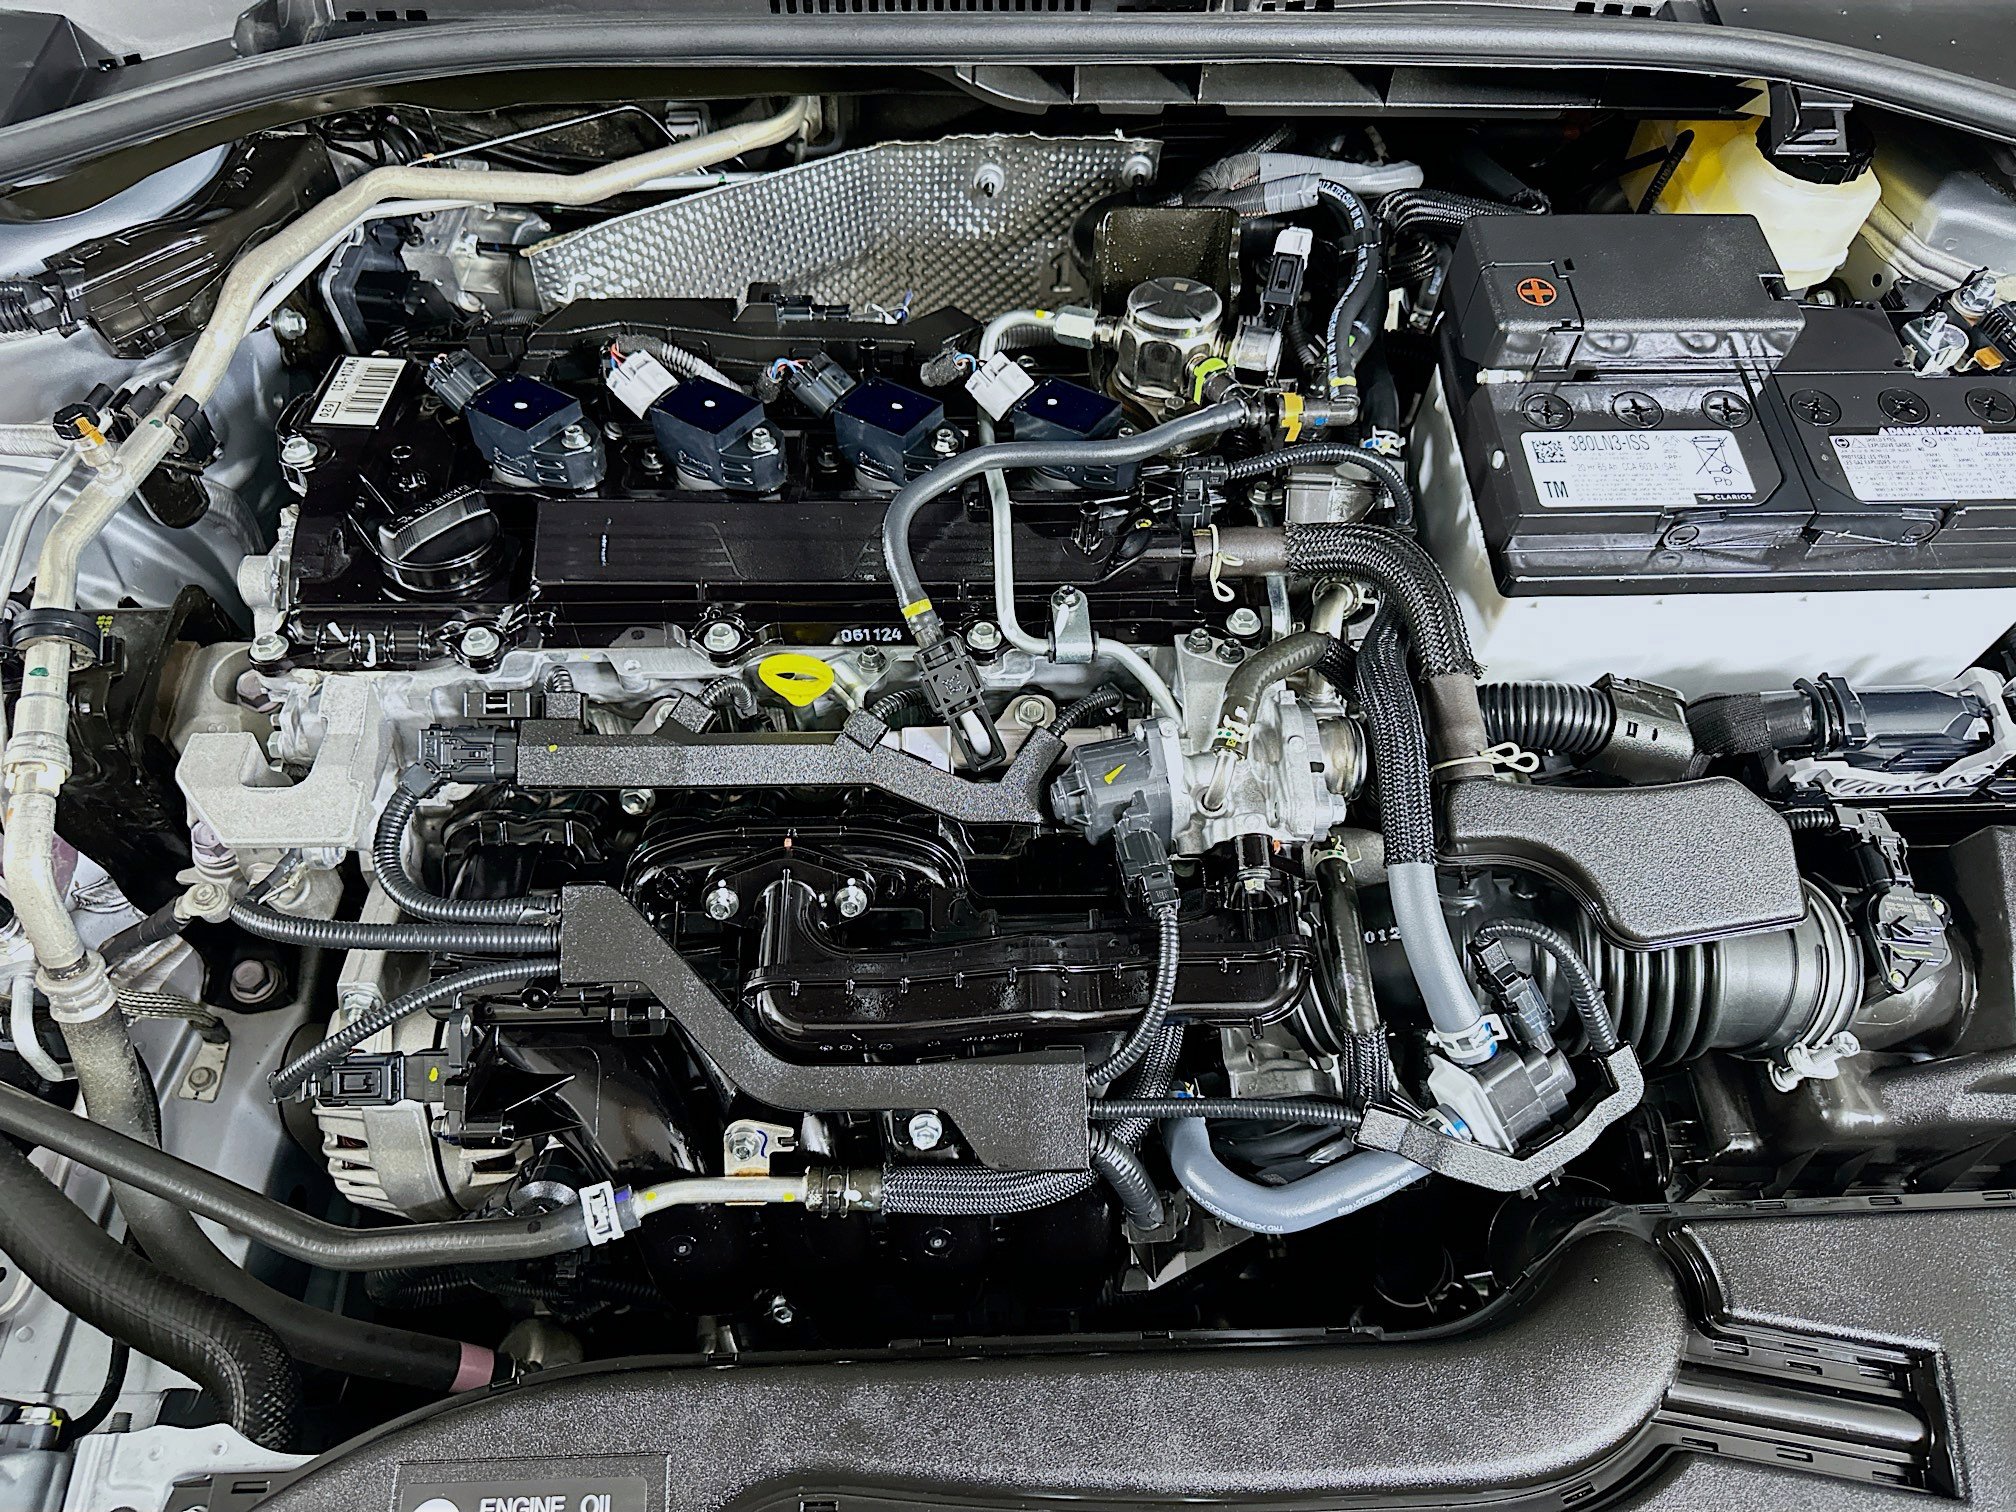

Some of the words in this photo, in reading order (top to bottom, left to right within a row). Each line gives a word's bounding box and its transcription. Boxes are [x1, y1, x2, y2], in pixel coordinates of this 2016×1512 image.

[1568, 434, 1650, 452] 380LN3-ISS
[1713, 476, 1733, 486] Pb
[1543, 480, 1569, 498] TM
[1714, 492, 1753, 501] CLARIOS
[841, 627, 902, 642] 061124
